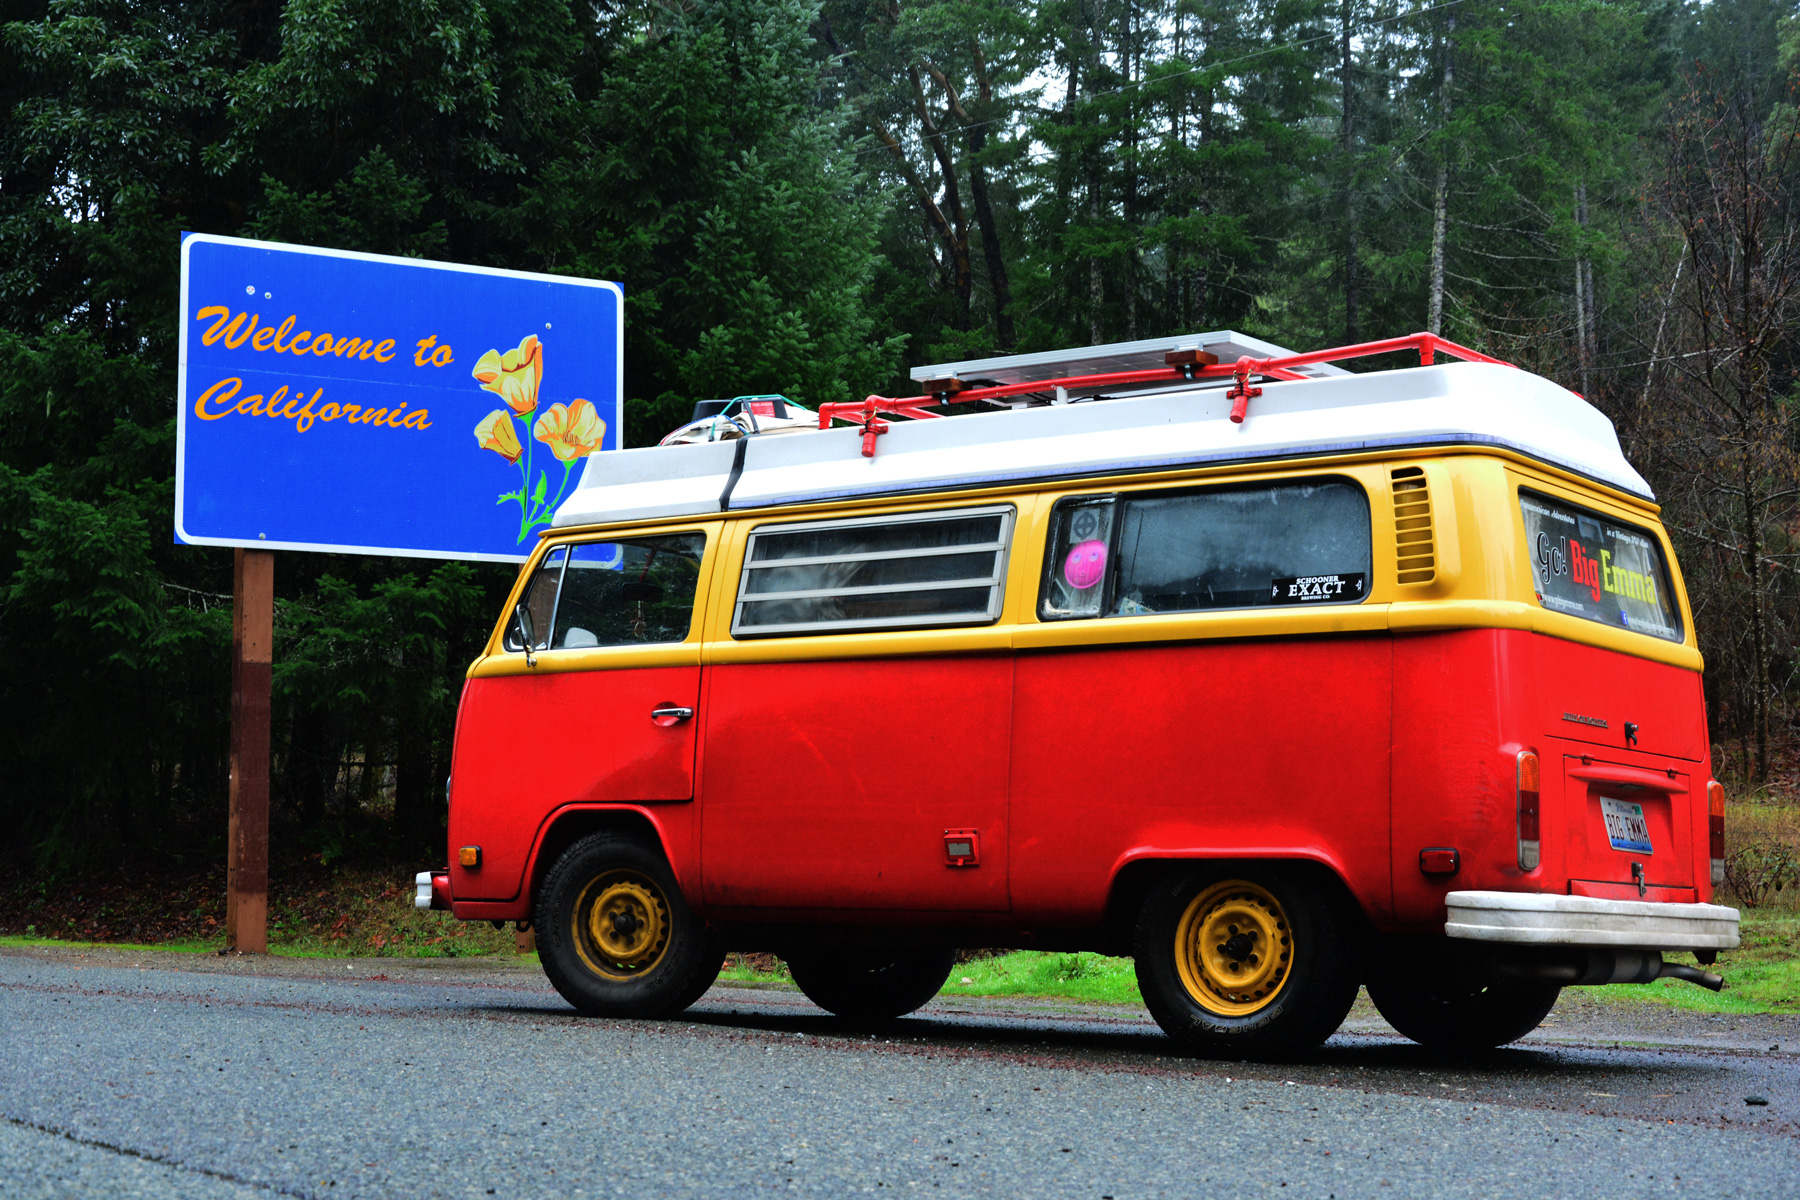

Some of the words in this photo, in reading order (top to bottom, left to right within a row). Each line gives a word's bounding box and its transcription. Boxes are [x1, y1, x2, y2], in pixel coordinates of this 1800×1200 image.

[196, 305, 396, 363] Welcome
[414, 334, 454, 368] to
[194, 377, 433, 433] California
[1296, 575, 1339, 585] SCHOONER
[1536, 531, 1568, 584] Go!
[1569, 539, 1601, 603] Big
[1600, 548, 1657, 605] Emma
[1288, 580, 1346, 597] EXACT
[1605, 813, 1625, 841] BIG
[1624, 816, 1651, 844] EMMA
[1190, 1004, 1284, 1034] GENERAL
